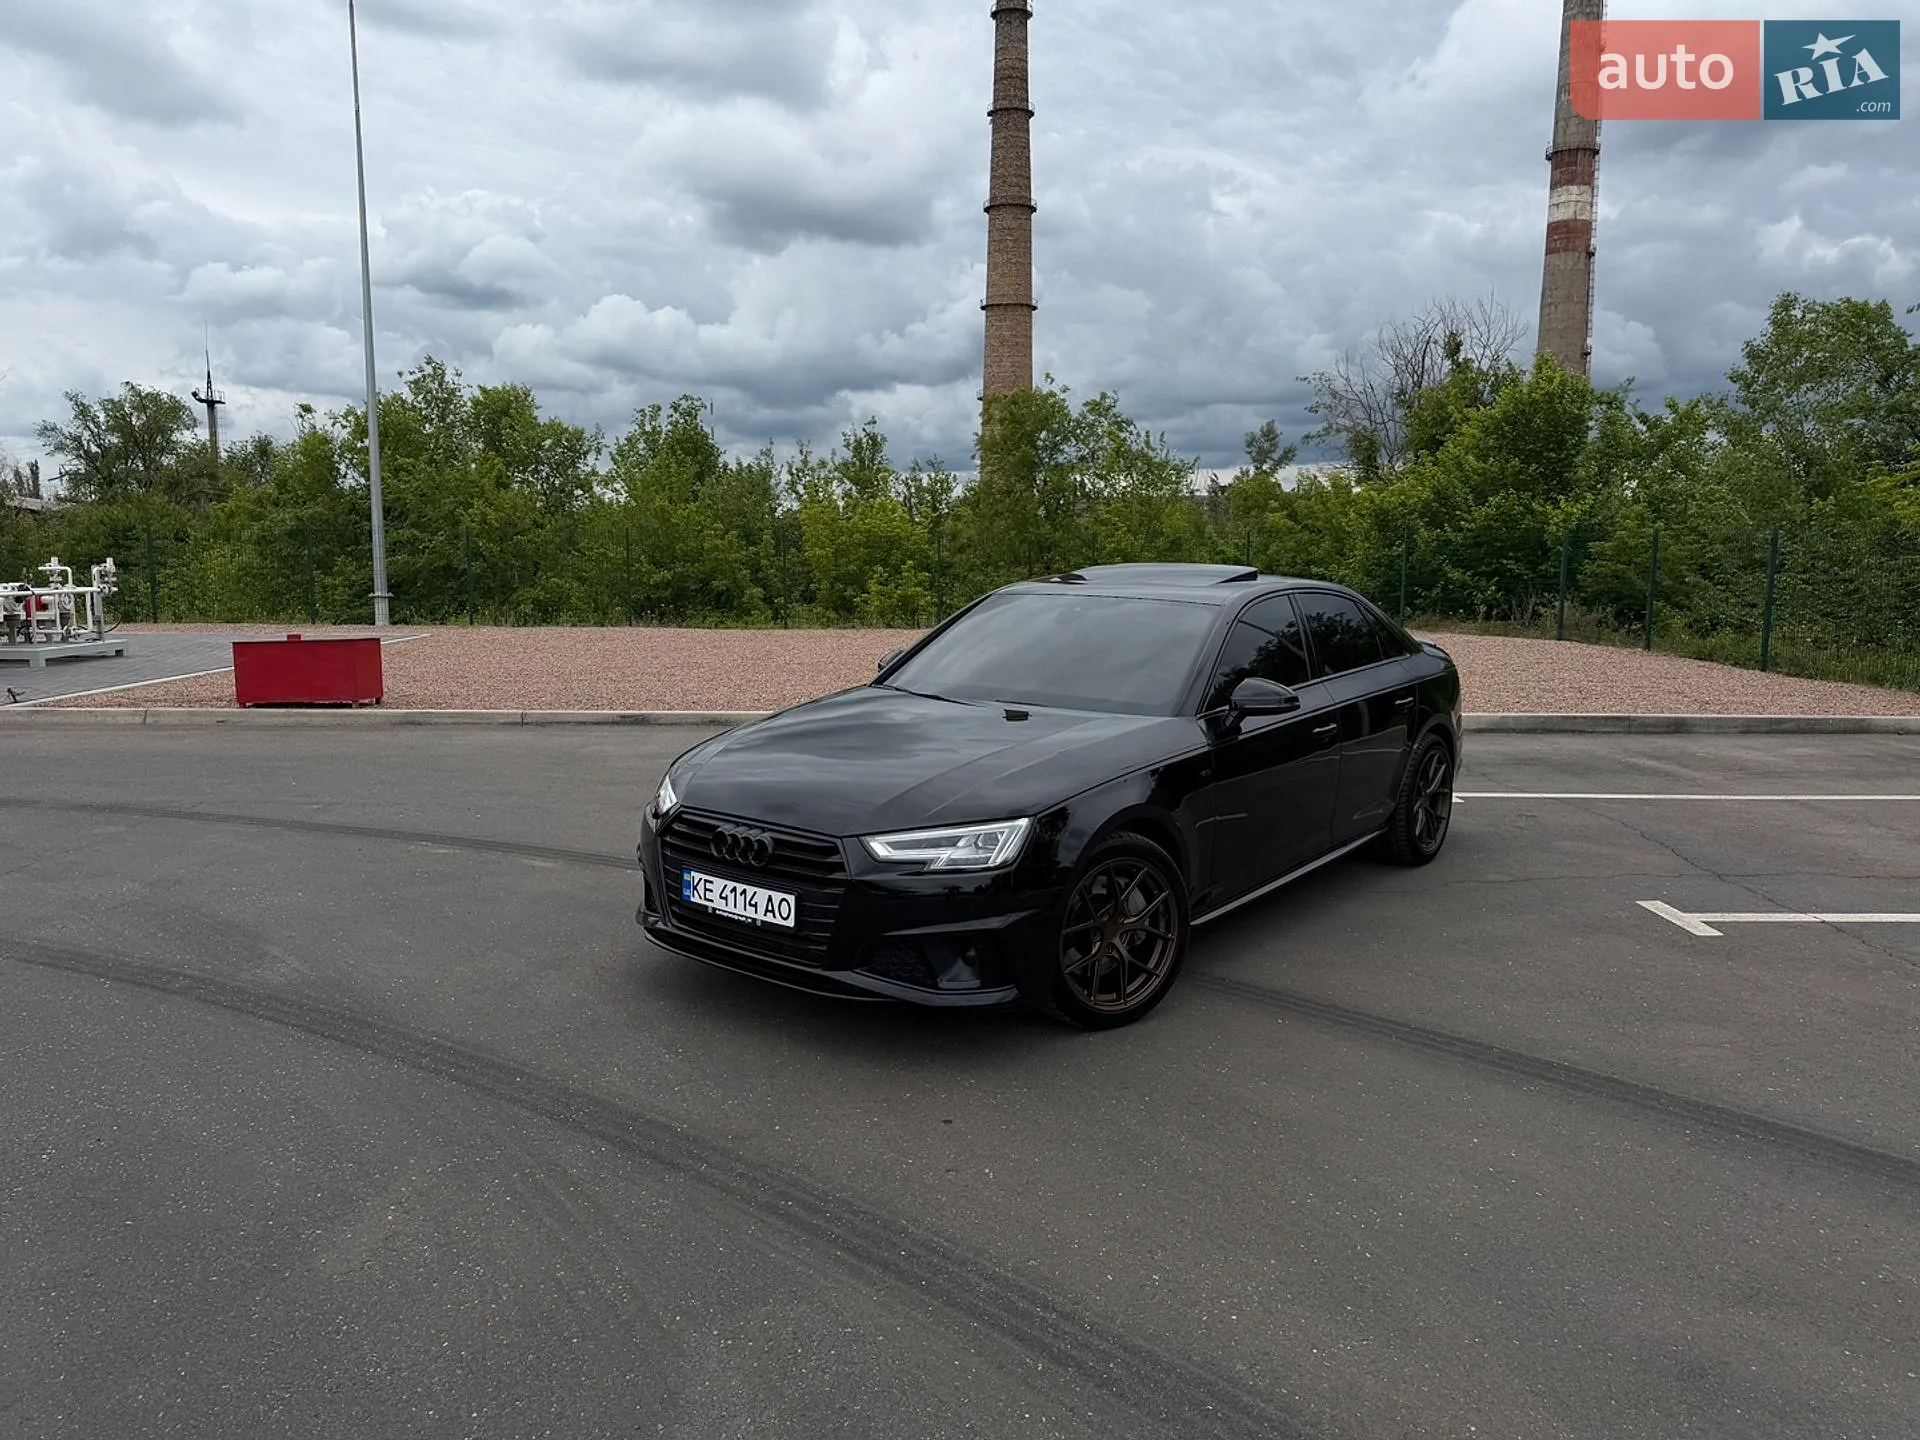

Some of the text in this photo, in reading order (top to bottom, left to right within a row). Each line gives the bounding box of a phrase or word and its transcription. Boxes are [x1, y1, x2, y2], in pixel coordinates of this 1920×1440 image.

[691, 876, 715, 903] KE
[719, 884, 758, 915] 4114
[763, 894, 792, 921] AO
